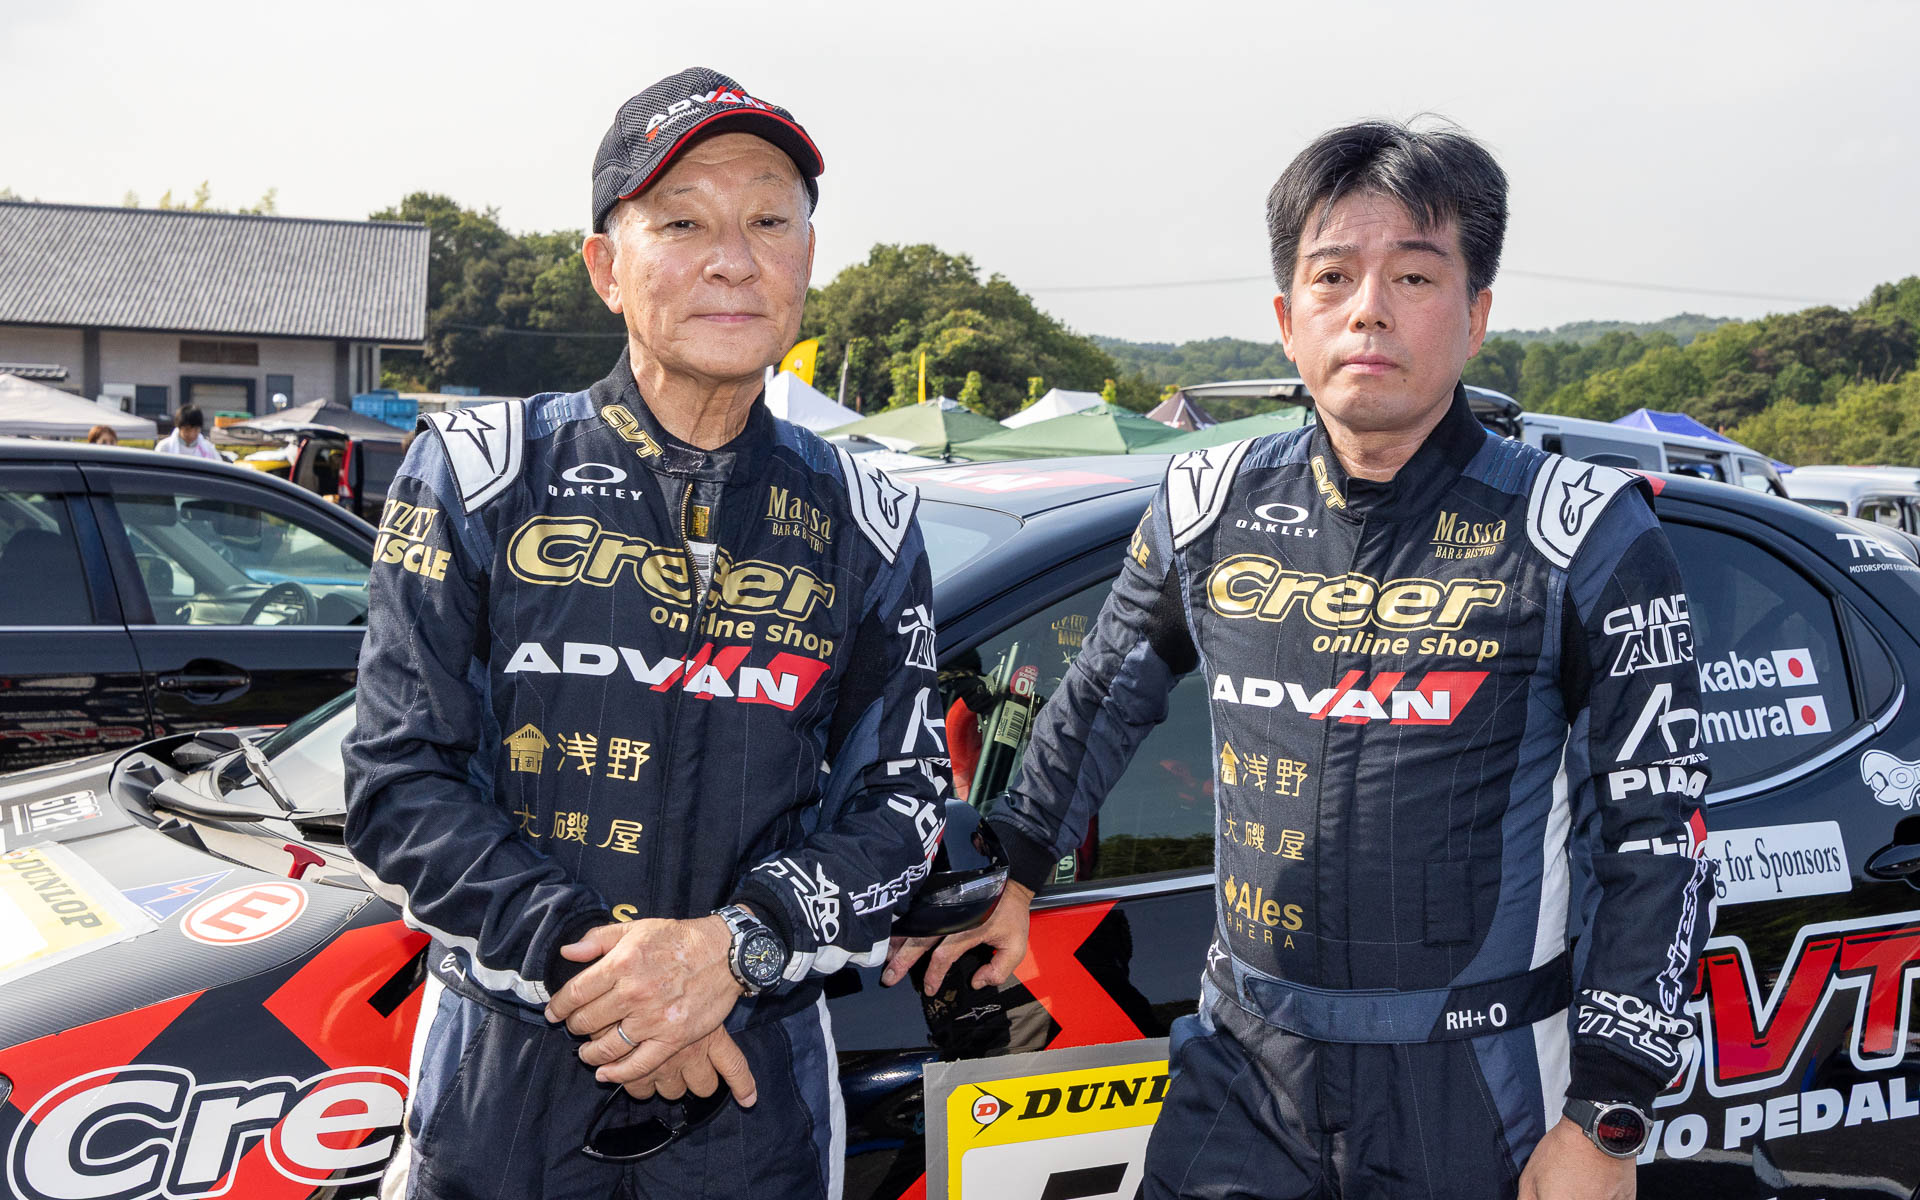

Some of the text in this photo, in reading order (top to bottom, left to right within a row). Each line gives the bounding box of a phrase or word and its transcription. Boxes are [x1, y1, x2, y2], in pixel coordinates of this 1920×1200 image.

[645, 87, 768, 134] ADVAN
[547, 484, 643, 501] OAKLEY
[766, 485, 831, 540] Massa
[772, 522, 824, 555] BAR & BTRO
[1235, 518, 1319, 539] OAKLEY
[1431, 510, 1507, 545] Massa
[506, 515, 836, 622] Creer
[1435, 545, 1496, 559] BAR & BISTRO
[1207, 554, 1505, 632] Creer
[765, 622, 834, 660] shop
[1312, 631, 1500, 663] online shop
[504, 642, 800, 707] ADVAN
[1697, 651, 1777, 693] kabe
[1212, 673, 1452, 722] ADVAN
[1701, 704, 1791, 745] mura
[557, 732, 652, 783] 浅野
[1242, 752, 1309, 797] 浅野
[1223, 811, 1306, 861] 大磯屋
[1725, 839, 1757, 884] for
[1754, 838, 1842, 894] Sponsors
[9, 858, 103, 929] DUNLOP
[203, 891, 291, 935] E
[1234, 881, 1304, 931] Ales
[1017, 1075, 1172, 1120] DUNL
[1724, 1077, 1920, 1150] PEDAL
[8, 1064, 410, 1200] Cre
